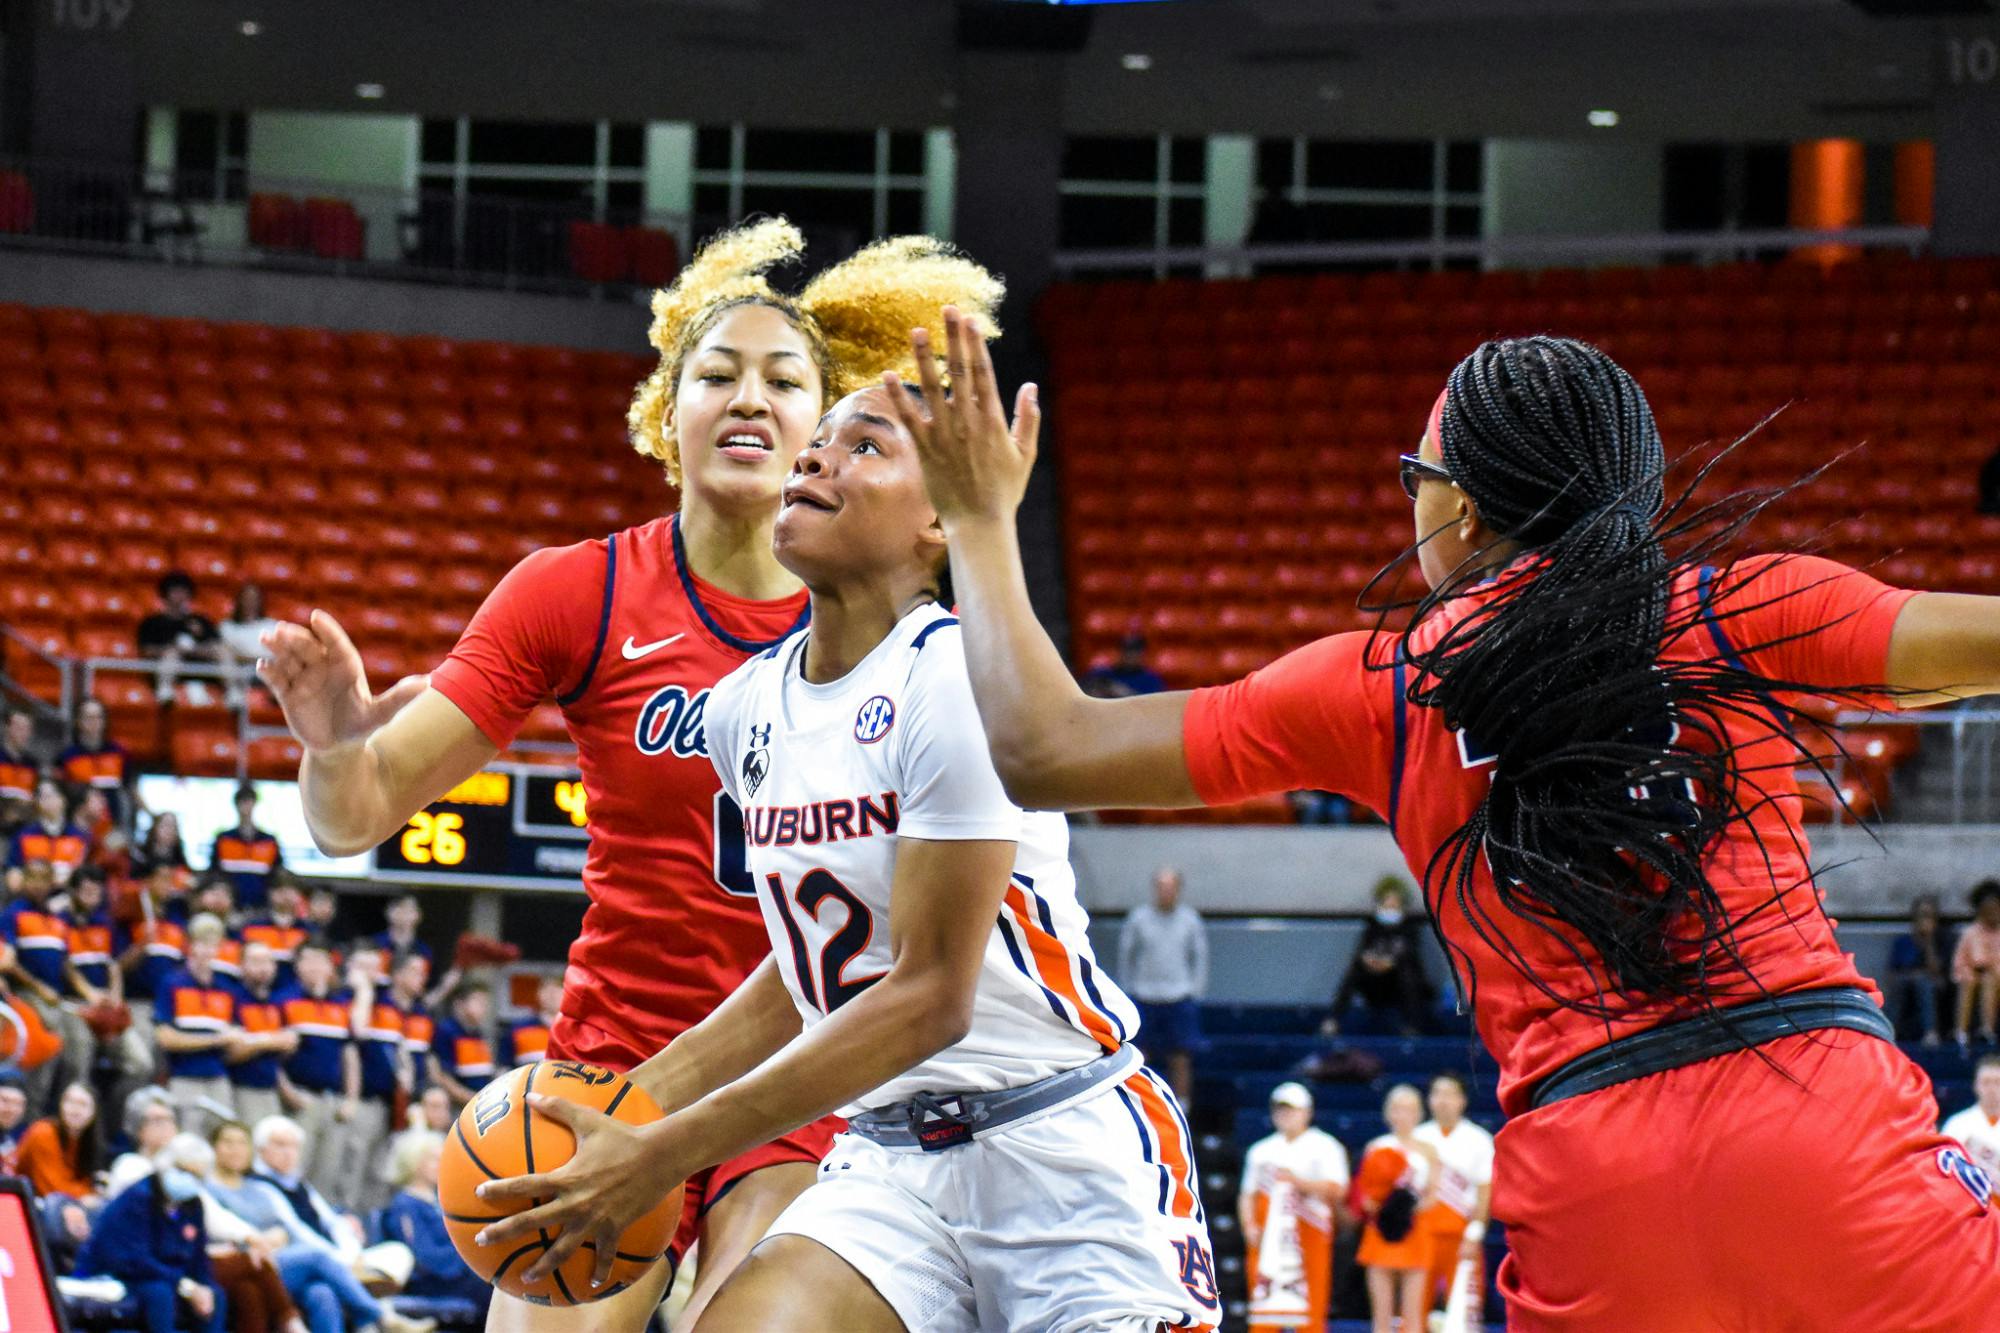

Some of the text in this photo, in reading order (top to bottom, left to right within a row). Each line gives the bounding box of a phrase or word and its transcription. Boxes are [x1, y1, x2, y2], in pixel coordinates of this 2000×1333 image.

[856, 697, 894, 743] SEC
[401, 811, 466, 865] 26
[765, 868, 889, 1014] 12
